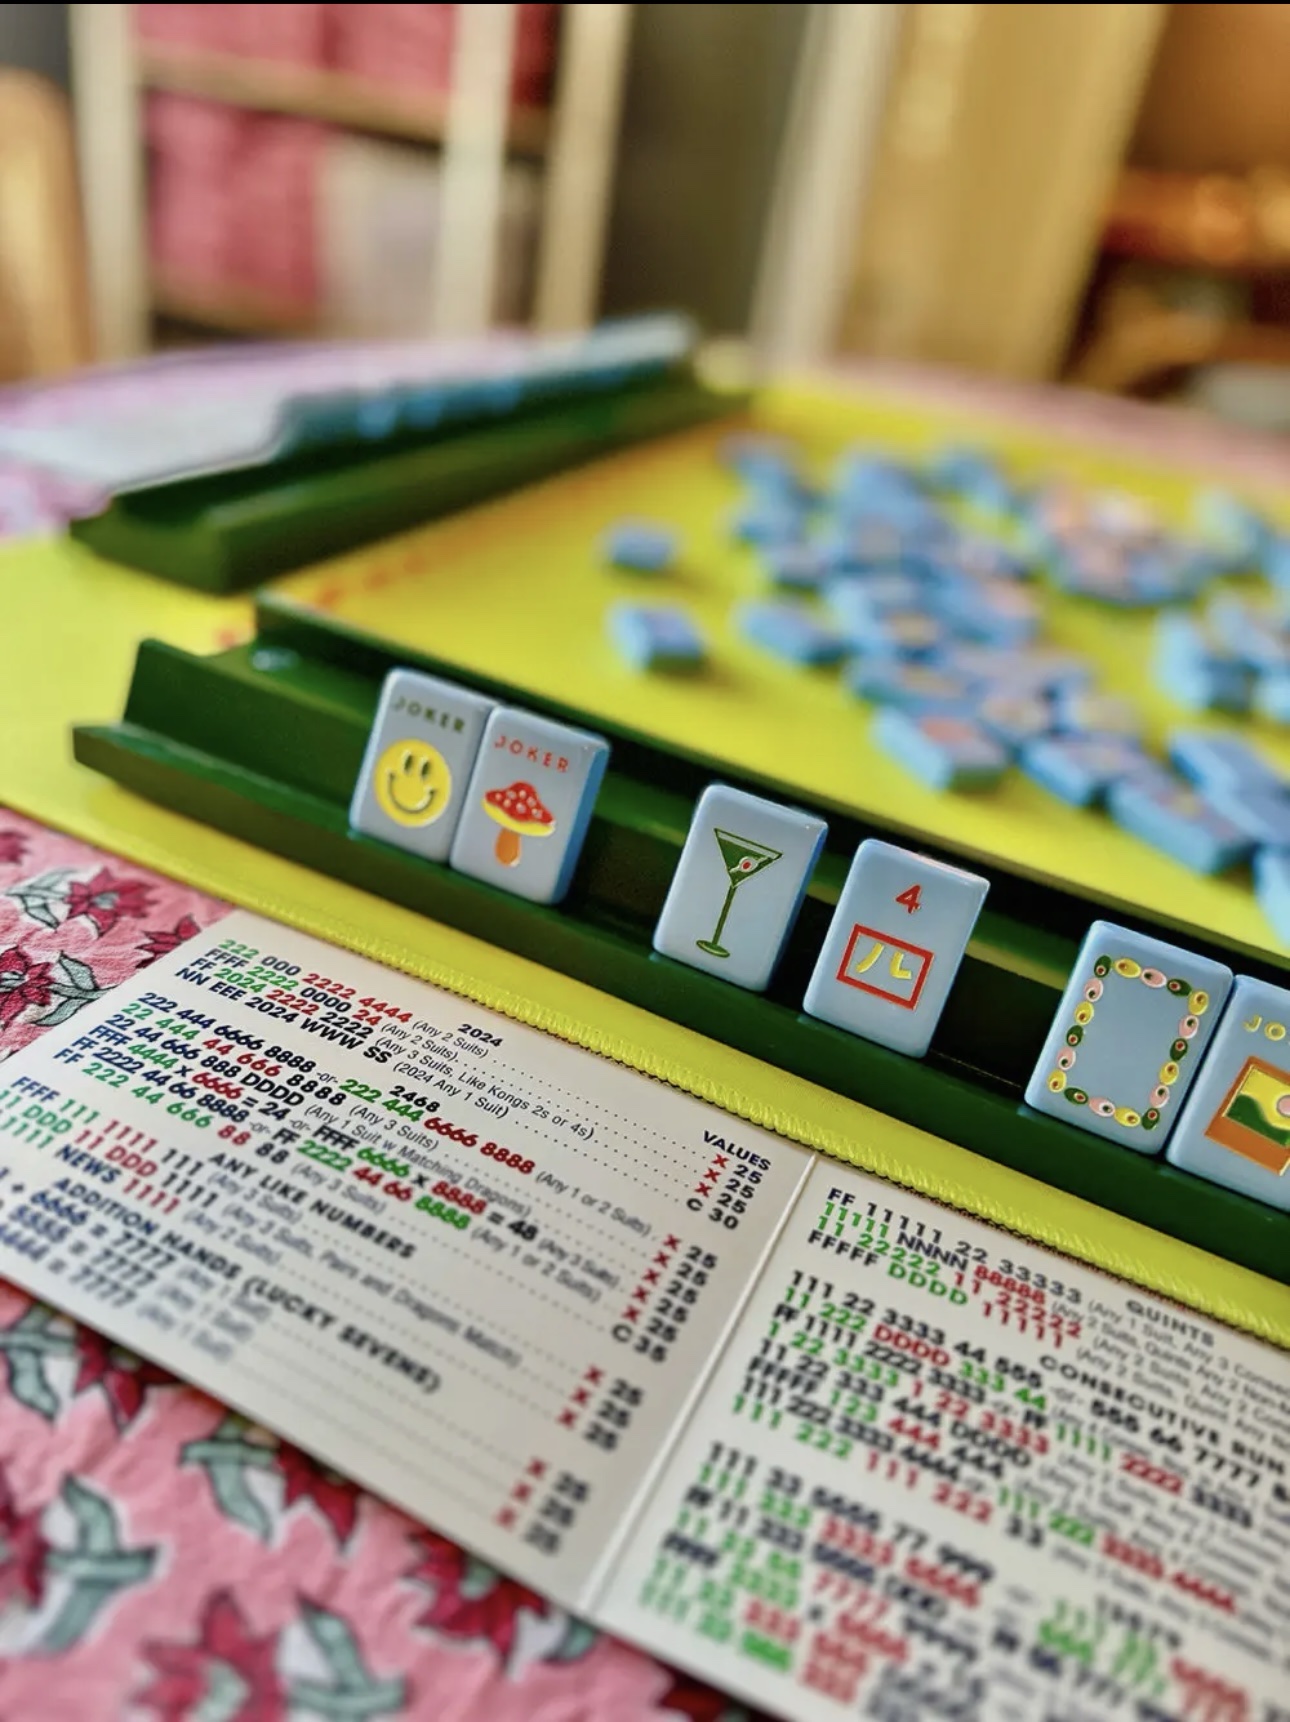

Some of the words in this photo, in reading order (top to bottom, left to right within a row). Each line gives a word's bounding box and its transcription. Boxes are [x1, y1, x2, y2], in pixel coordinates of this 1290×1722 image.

[495, 735, 569, 773] JOKER
[895, 884, 921, 914] 4
[190, 957, 217, 971] FF
[214, 968, 267, 993] 2024
[266, 989, 320, 1016] 2222
[319, 1011, 374, 1039] 2222
[374, 1036, 407, 1055] (Any
[407, 1049, 420, 1060] 3
[419, 1054, 453, 1078] Suits,
[458, 1071, 486, 1090] Like
[487, 1085, 530, 1110] Kongs
[531, 1104, 550, 1119] 2s
[551, 1115, 569, 1127] or
[570, 1123, 595, 1141] 4s)
[694, 1182, 713, 1198] X
[717, 1192, 747, 1214] 25
[204, 948, 249, 968] FFFF
[247, 966, 299, 991] 2222
[300, 987, 352, 1013] 0000
[352, 1009, 383, 1026] 24
[380, 1023, 410, 1041] (Any
[409, 1034, 423, 1045] 2
[703, 1168, 721, 1183] X
[725, 1178, 755, 1199] 25
[219, 939, 259, 960] 222
[261, 956, 302, 976] 000
[302, 973, 356, 1000] 2222
[359, 997, 413, 1023] 4444
[412, 1020, 442, 1038] (Any
[441, 1032, 454, 1042] 2
[453, 1037, 489, 1059] Suits)
[711, 1153, 729, 1169] X
[733, 1164, 763, 1185] 25
[457, 1023, 503, 1047] 2024
[11, 1076, 60, 1102] FFFF
[59, 1098, 100, 1124] 111
[103, 1120, 158, 1153] 1111
[161, 1148, 204, 1176] 111
[22, 1105, 72, 1134] DDD
[75, 1129, 105, 1150] 11
[105, 1145, 158, 1177] DDD
[162, 1172, 218, 1208] 1111
[121, 1002, 154, 1021] 22
[155, 1018, 200, 1041] 444
[202, 1038, 235, 1056] 44
[236, 1053, 282, 1077] 666
[286, 1074, 347, 1106] 8888
[349, 1104, 384, 1126] (Any
[383, 1119, 398, 1131] 3
[396, 1125, 439, 1152] Suits)
[653, 1251, 670, 1268] X
[677, 1262, 707, 1286] 25
[138, 992, 178, 1013] 222
[176, 1009, 217, 1029] 444
[213, 1025, 265, 1051] 6666
[264, 1046, 316, 1073] 8888
[339, 1079, 382, 1104] 222
[382, 1098, 424, 1122] 444
[424, 1117, 478, 1147] 6666
[480, 1142, 535, 1174] 8888
[663, 1235, 680, 1251] X
[686, 1246, 717, 1269] 25
[175, 967, 210, 986] NN
[209, 981, 247, 1001] EEE
[244, 996, 299, 1023] 2024
[300, 1018, 364, 1050] WWW
[363, 1046, 392, 1064] SS
[393, 1061, 434, 1083] (2024
[433, 1079, 462, 1097] Any
[464, 1091, 473, 1101] 1
[474, 1097, 509, 1119] Suit)
[686, 1197, 703, 1212] C
[709, 1207, 739, 1230] 30
[389, 1085, 440, 1113] 2468
[704, 1131, 771, 1171] VALUES
[0, 1116, 54, 1149] 1111
[56, 1145, 121, 1183] NEWS
[123, 1178, 180, 1214] 1111
[53, 1048, 84, 1064] FF
[82, 1062, 129, 1088] 222
[131, 1086, 165, 1105] 44
[166, 1102, 213, 1128] 666
[217, 1125, 251, 1146] 88
[255, 1142, 290, 1164] 88
[635, 1336, 666, 1362] 35
[71, 1036, 100, 1051] FF
[92, 1046, 145, 1074] 2222
[141, 1070, 172, 1087] 44
[168, 1081, 199, 1100] 66
[196, 1094, 250, 1123] 8888
[272, 1127, 301, 1145] FF
[297, 1140, 353, 1172] 2222
[353, 1167, 384, 1187] 44
[383, 1181, 412, 1201] 66
[415, 1196, 471, 1230] 8888
[647, 1317, 677, 1342] 25
[88, 1025, 133, 1046] FFFF
[128, 1044, 179, 1070] 4444
[192, 1072, 244, 1100] 6666
[258, 1101, 291, 1121] 24
[312, 1124, 360, 1151] FFFF
[357, 1147, 410, 1178] 6666
[432, 1181, 487, 1214] 8888
[508, 1220, 538, 1241] 48
[656, 1298, 687, 1323] 25
[105, 1014, 136, 1031] 22
[133, 1027, 164, 1043] 44
[160, 1038, 202, 1060] 666
[200, 1055, 242, 1078] 888
[240, 1072, 305, 1106] DDDD
[304, 1104, 339, 1125] (Any
[341, 1119, 352, 1130] 1
[351, 1124, 382, 1144] Suit
[397, 1145, 463, 1185] Matching
[461, 1177, 531, 1219] Dragons)
[643, 1269, 660, 1285] X
[666, 1280, 698, 1304] 25
[209, 1153, 257, 1178] ANY
[259, 1175, 307, 1204] LIKE
[311, 1200, 414, 1258] NUMBERS
[56, 1179, 158, 1235] ADDITION
[163, 1233, 241, 1279] HANDS
[242, 1277, 335, 1328] (LUCKY
[340, 1326, 440, 1392] SEVENS)
[808, 1230, 878, 1266] FFFFF
[888, 1262, 968, 1305] DDDD
[984, 1302, 1063, 1348] 11111
[818, 1215, 845, 1237] 11
[857, 1233, 940, 1277] 22222
[955, 1272, 982, 1295] 11
[997, 1291, 1081, 1338] 22222
[825, 1201, 889, 1238] 11111
[897, 1232, 968, 1271] NNNN
[975, 1265, 1045, 1305] 88888
[827, 1187, 856, 1206] FF
[867, 1202, 942, 1244] 11111
[955, 1241, 988, 1264] 22
[999, 1259, 1081, 1304] 33333
